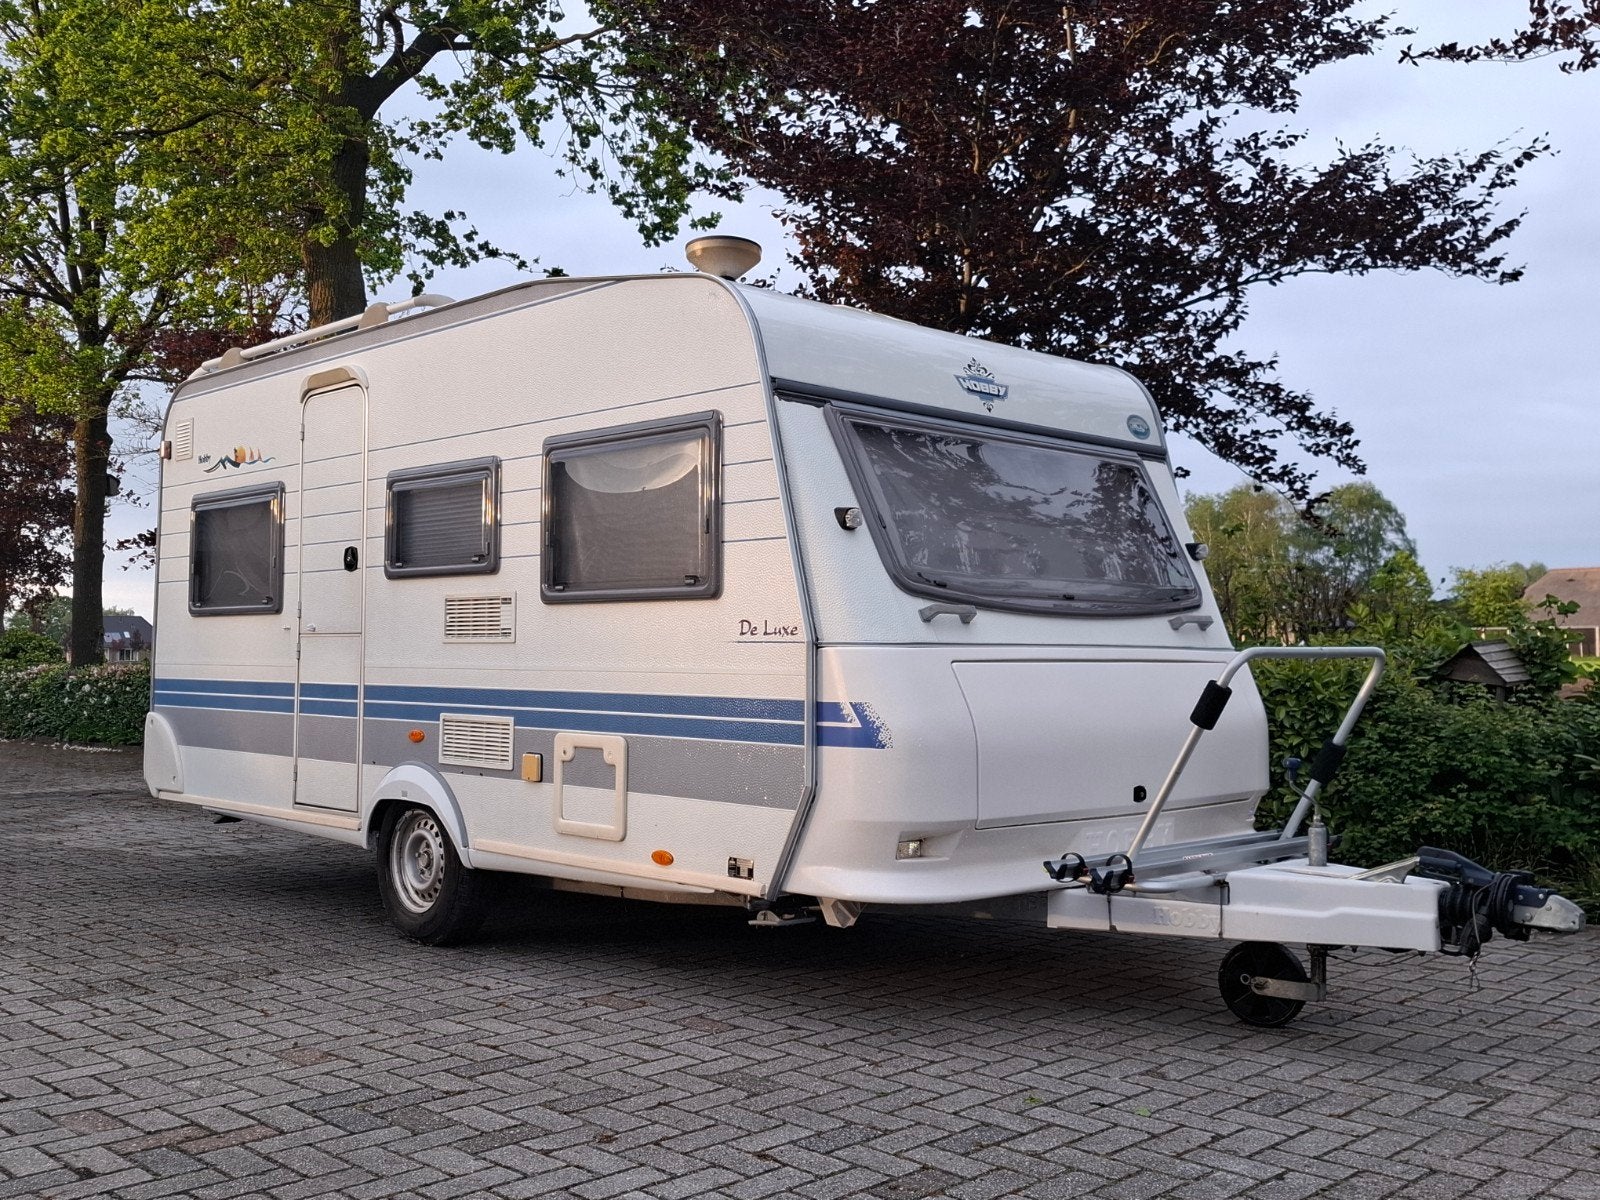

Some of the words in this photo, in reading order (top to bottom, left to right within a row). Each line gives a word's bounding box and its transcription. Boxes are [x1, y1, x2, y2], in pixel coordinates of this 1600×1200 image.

[959, 377, 1007, 396] HOBBY
[738, 619, 758, 636] De
[763, 619, 799, 638] Luxe
